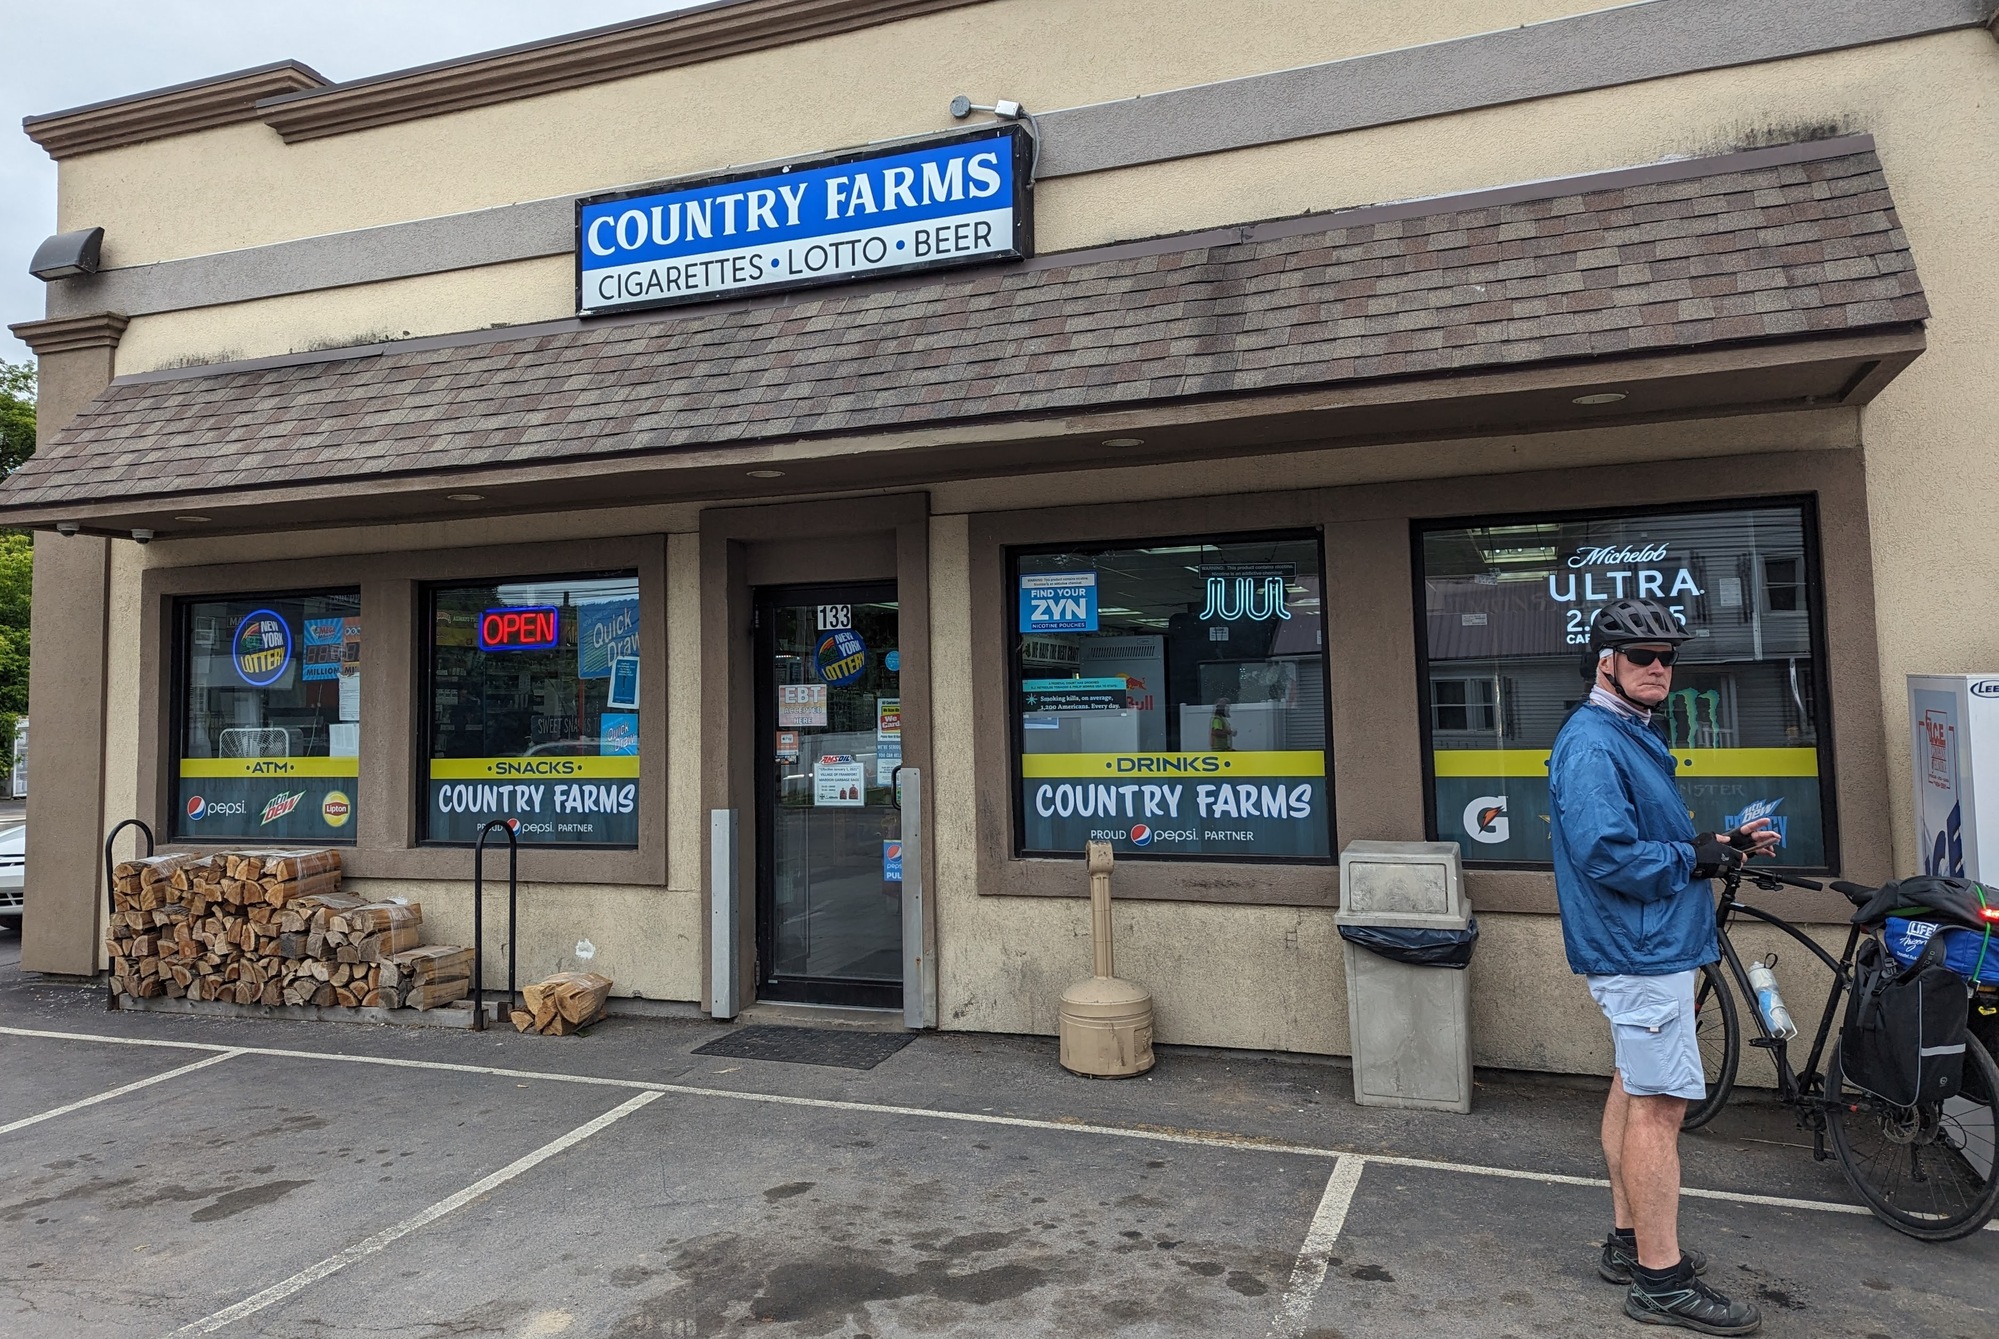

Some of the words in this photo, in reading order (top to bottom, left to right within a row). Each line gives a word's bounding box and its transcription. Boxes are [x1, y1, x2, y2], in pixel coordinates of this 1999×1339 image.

[587, 182, 809, 256] COUNTRY
[825, 151, 1001, 220] FARMS
[598, 253, 764, 301] CIGARETTES
[788, 236, 887, 274] LOTTO
[915, 220, 992, 258] BEER
[1567, 542, 1670, 568] Michelob
[1031, 589, 1055, 598] FIND
[1056, 588, 1086, 597] YOUR
[1549, 568, 1701, 602] ULTRA
[1199, 577, 1292, 621] JUUL
[820, 605, 850, 628] 133
[1031, 598, 1086, 620] ZYN
[260, 620, 279, 633] NEW
[483, 613, 554, 645] OPEN
[593, 607, 633, 649] Quick
[262, 632, 284, 648] YORK
[834, 631, 854, 644] NEW
[838, 639, 862, 657] YORK
[240, 647, 286, 673] LOTTERY
[821, 651, 865, 681] LOTTERY
[306, 667, 340, 676] MILLION
[784, 686, 821, 704] EBT
[1040, 694, 1066, 703] Smoking
[1066, 694, 1081, 702] kills,
[784, 706, 823, 715] ACCEPTED
[1057, 702, 1090, 711] Americans.
[1091, 702, 1107, 711] Every
[1108, 702, 1121, 710] day.
[538, 718, 562, 734] SWEET
[794, 717, 812, 725] HERE
[881, 720, 900, 728] Card
[607, 721, 630, 741] Quick
[614, 733, 635, 752] Draw
[252, 761, 288, 774] ATM
[495, 761, 575, 775] SNACKS
[821, 755, 851, 764] AMSOIL
[1116, 756, 1219, 773] DRINKS
[438, 784, 544, 814] COUNTRY
[553, 783, 636, 814] FARMS
[1035, 783, 1183, 818] COUNTRY
[1196, 783, 1312, 819] FARMS
[208, 800, 245, 817] pepsi
[326, 804, 347, 814] Lipton
[522, 822, 553, 834] pepsi
[558, 824, 593, 833] PARTNER
[1463, 796, 1509, 844] G
[1091, 829, 1127, 840] PROUD
[1154, 828, 1198, 842] pepsi
[1204, 830, 1254, 841] PARTNER
[886, 871, 902, 880] PUL
[1911, 922, 1934, 937] LIFE
